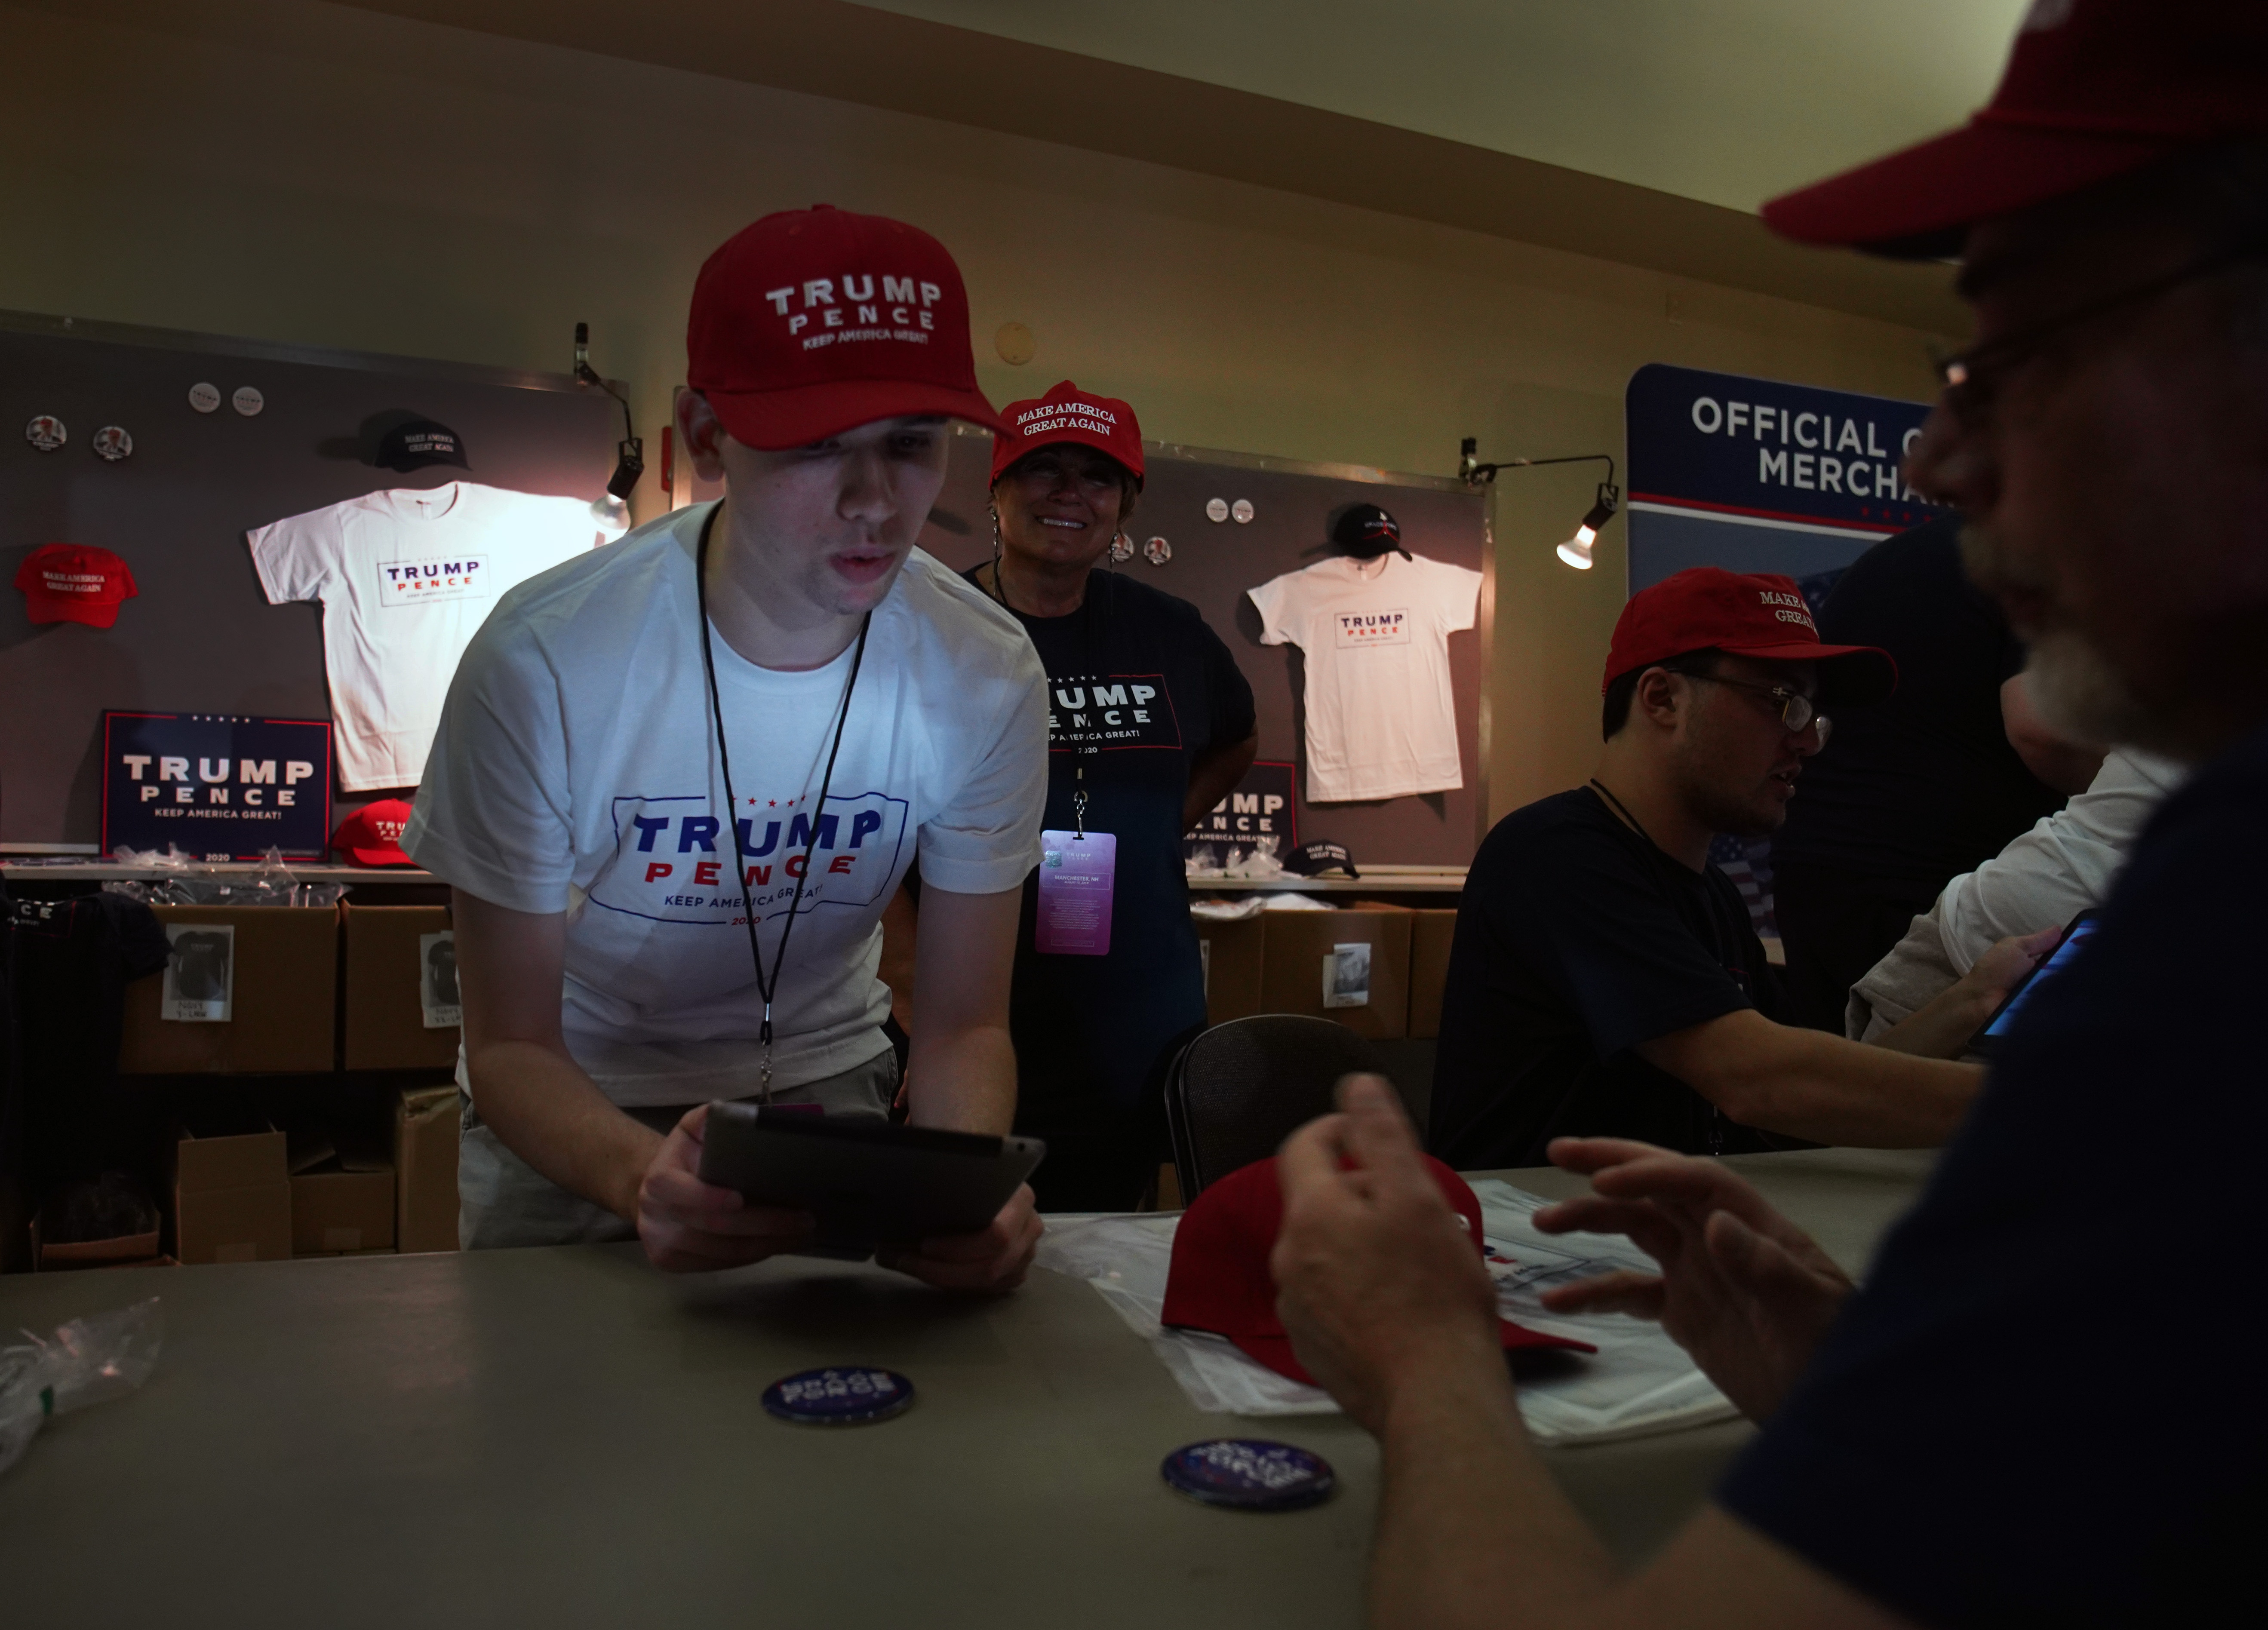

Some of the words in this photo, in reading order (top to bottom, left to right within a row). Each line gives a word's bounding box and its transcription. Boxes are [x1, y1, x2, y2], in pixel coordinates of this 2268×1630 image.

[765, 273, 942, 316] TRUMP
[788, 304, 935, 336] PENCE
[802, 332, 836, 351] KEEP
[837, 328, 892, 344] AMERICA
[1017, 405, 1054, 425] MAKE
[1054, 403, 1117, 424] AMERICA
[1023, 417, 1066, 436] GREAT
[1067, 417, 1110, 436] AGAIN
[1691, 396, 1887, 458] OFFICIAL
[387, 562, 479, 580] TRUMP
[397, 577, 471, 591] PENCE
[1759, 591, 1801, 608] MAKE
[1341, 614, 1402, 628] TRUMP
[1348, 627, 1397, 636] PENCE
[1056, 685, 1156, 709] UMP
[1049, 709, 1151, 728] ENCE
[1105, 730, 1140, 739] GREAT!
[123, 754, 314, 785] TRUMP
[140, 785, 296, 807] PENCE
[154, 807, 184, 818] KEEP
[187, 809, 239, 819] AMERICA
[241, 810, 282, 820] GREAT!
[375, 820, 406, 831] TRU
[633, 810, 881, 856] TRUMP
[1195, 816, 1273, 832] NCE
[205, 853, 230, 862] 2020
[645, 855, 856, 887] PENCE
[665, 896, 704, 907] KEEP
[709, 895, 774, 908] AMEICA
[731, 916, 761, 925] 200
